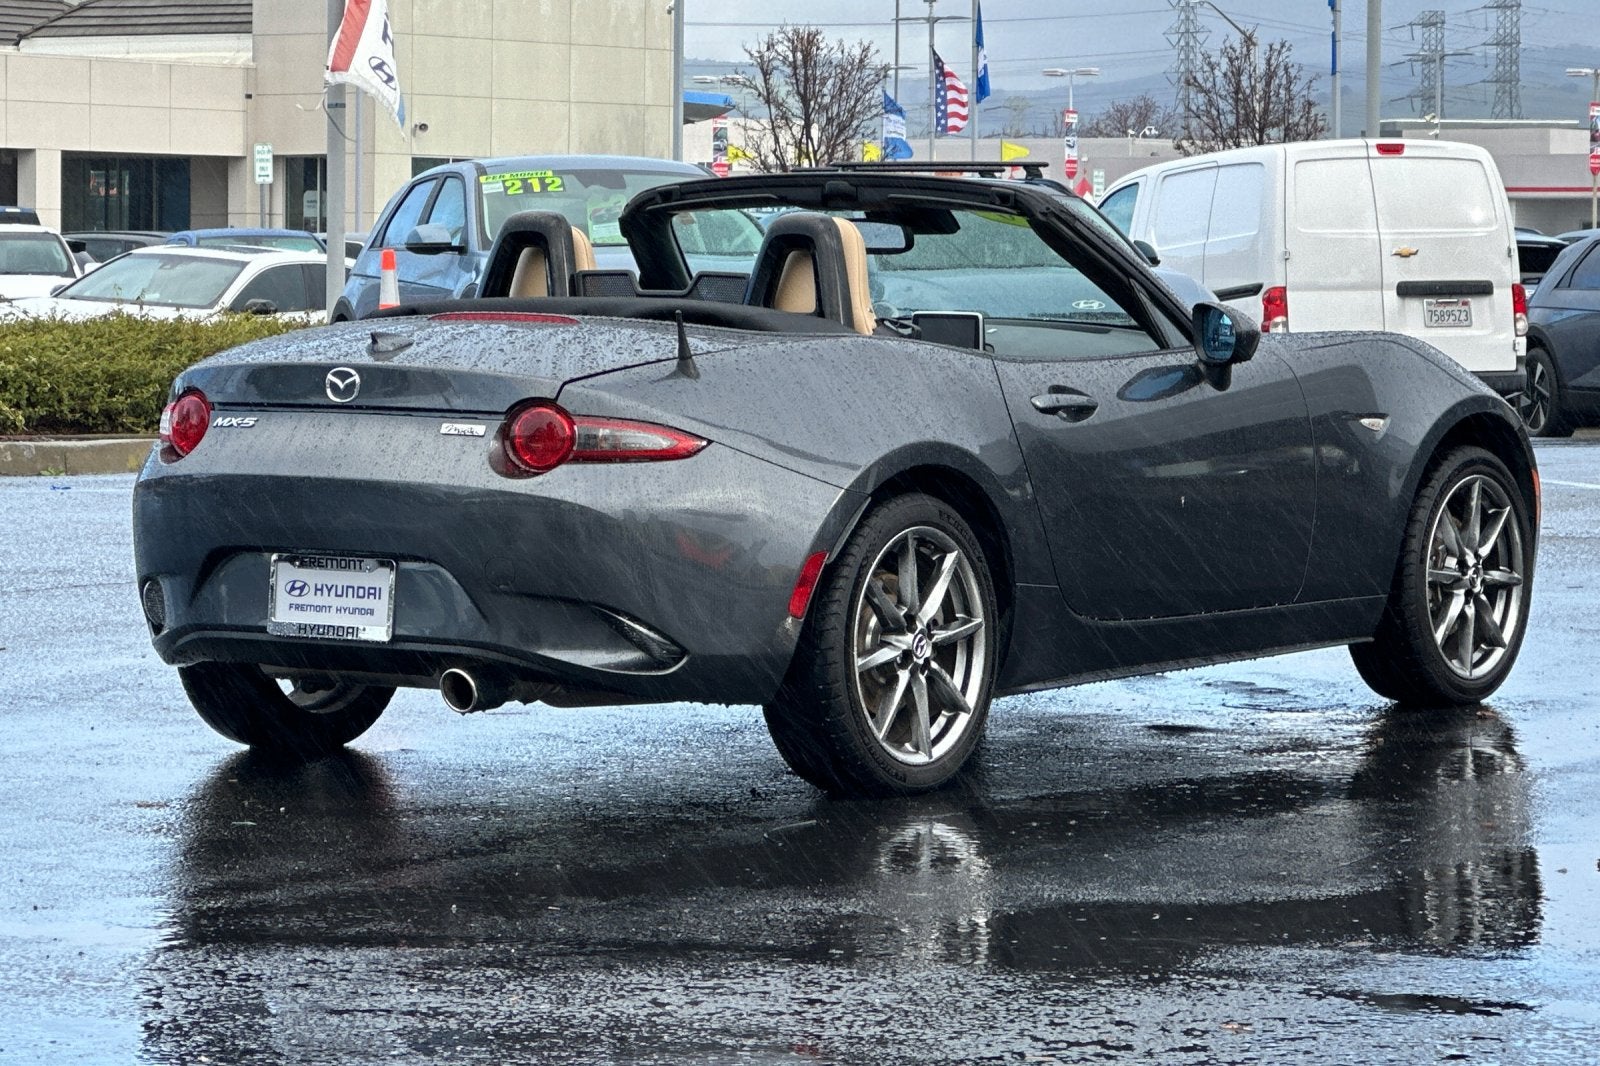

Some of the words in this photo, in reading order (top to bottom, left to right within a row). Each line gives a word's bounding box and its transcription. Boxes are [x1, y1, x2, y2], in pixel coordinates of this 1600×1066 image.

[504, 176, 564, 195] 212
[213, 417, 258, 428] MX-5
[301, 557, 364, 570] FREMONT
[314, 583, 382, 600] HYUNDAI
[289, 603, 333, 614] FREMONT
[335, 607, 374, 616] HYUNDAI
[298, 623, 359, 638] HYUNDAI
